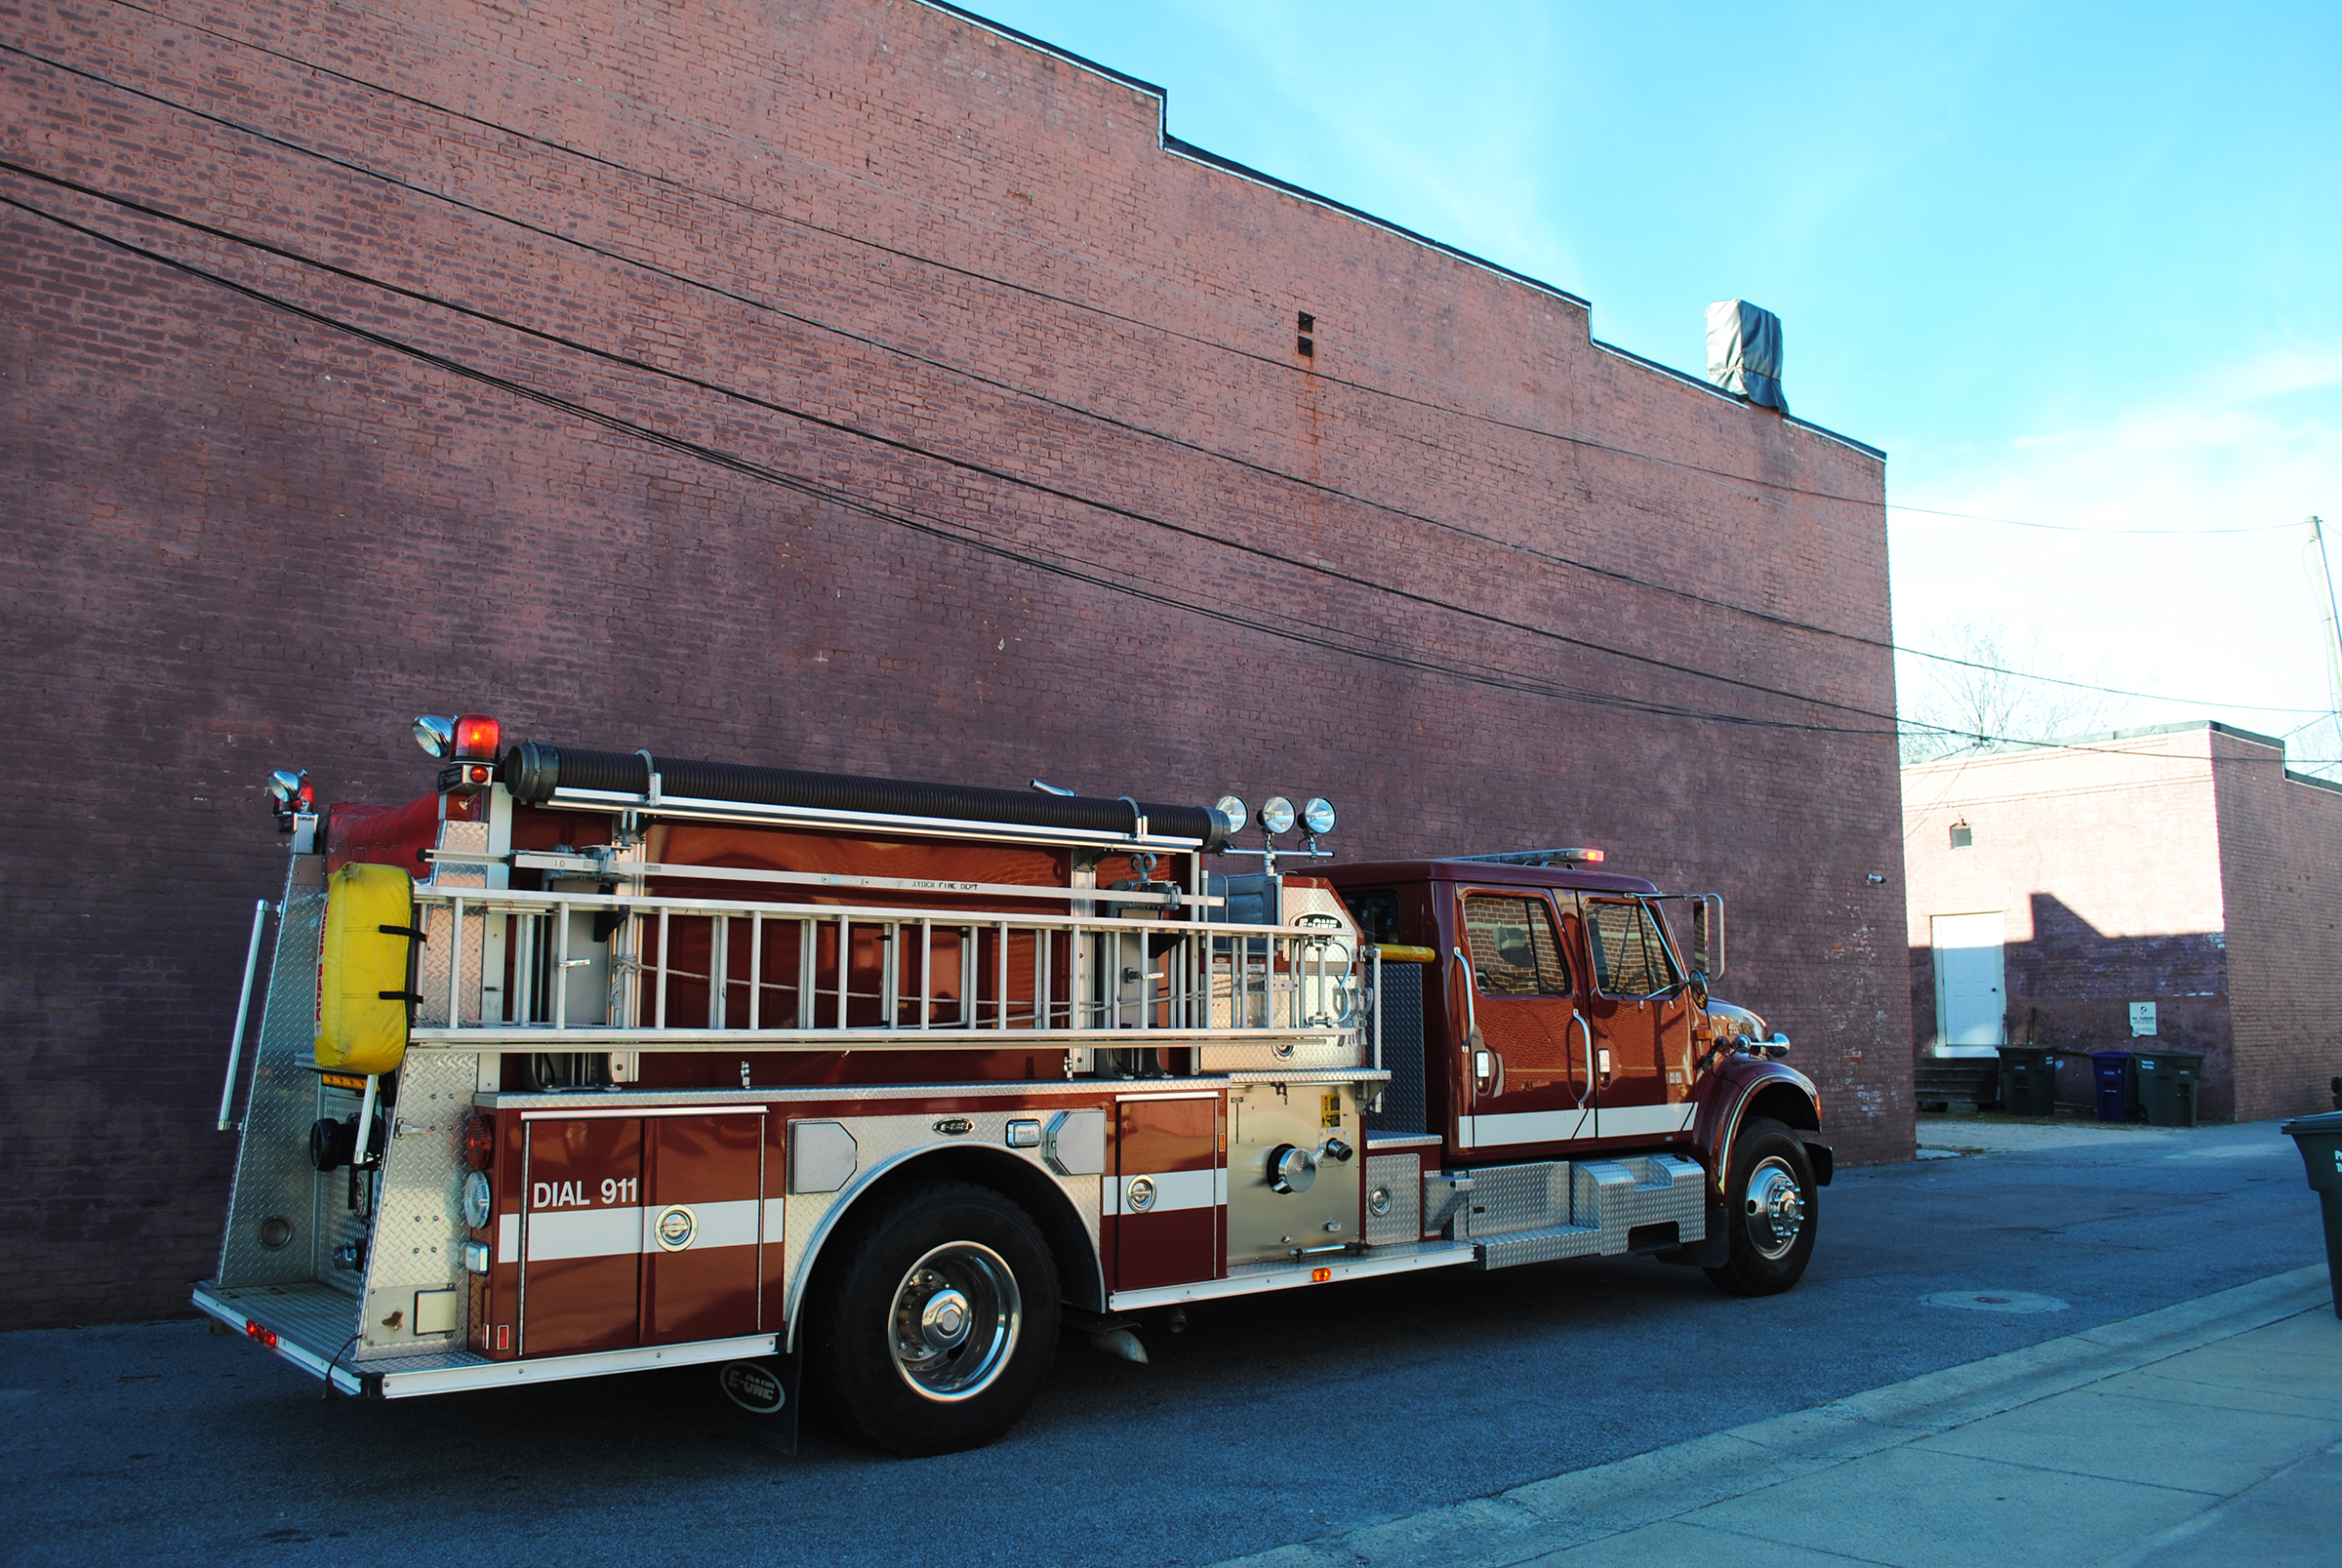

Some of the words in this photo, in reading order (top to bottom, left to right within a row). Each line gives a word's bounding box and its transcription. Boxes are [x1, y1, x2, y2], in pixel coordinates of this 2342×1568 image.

[534, 1181, 590, 1208] DIAL
[600, 1178, 637, 1204] 911
[728, 1369, 775, 1401] E-ONE
